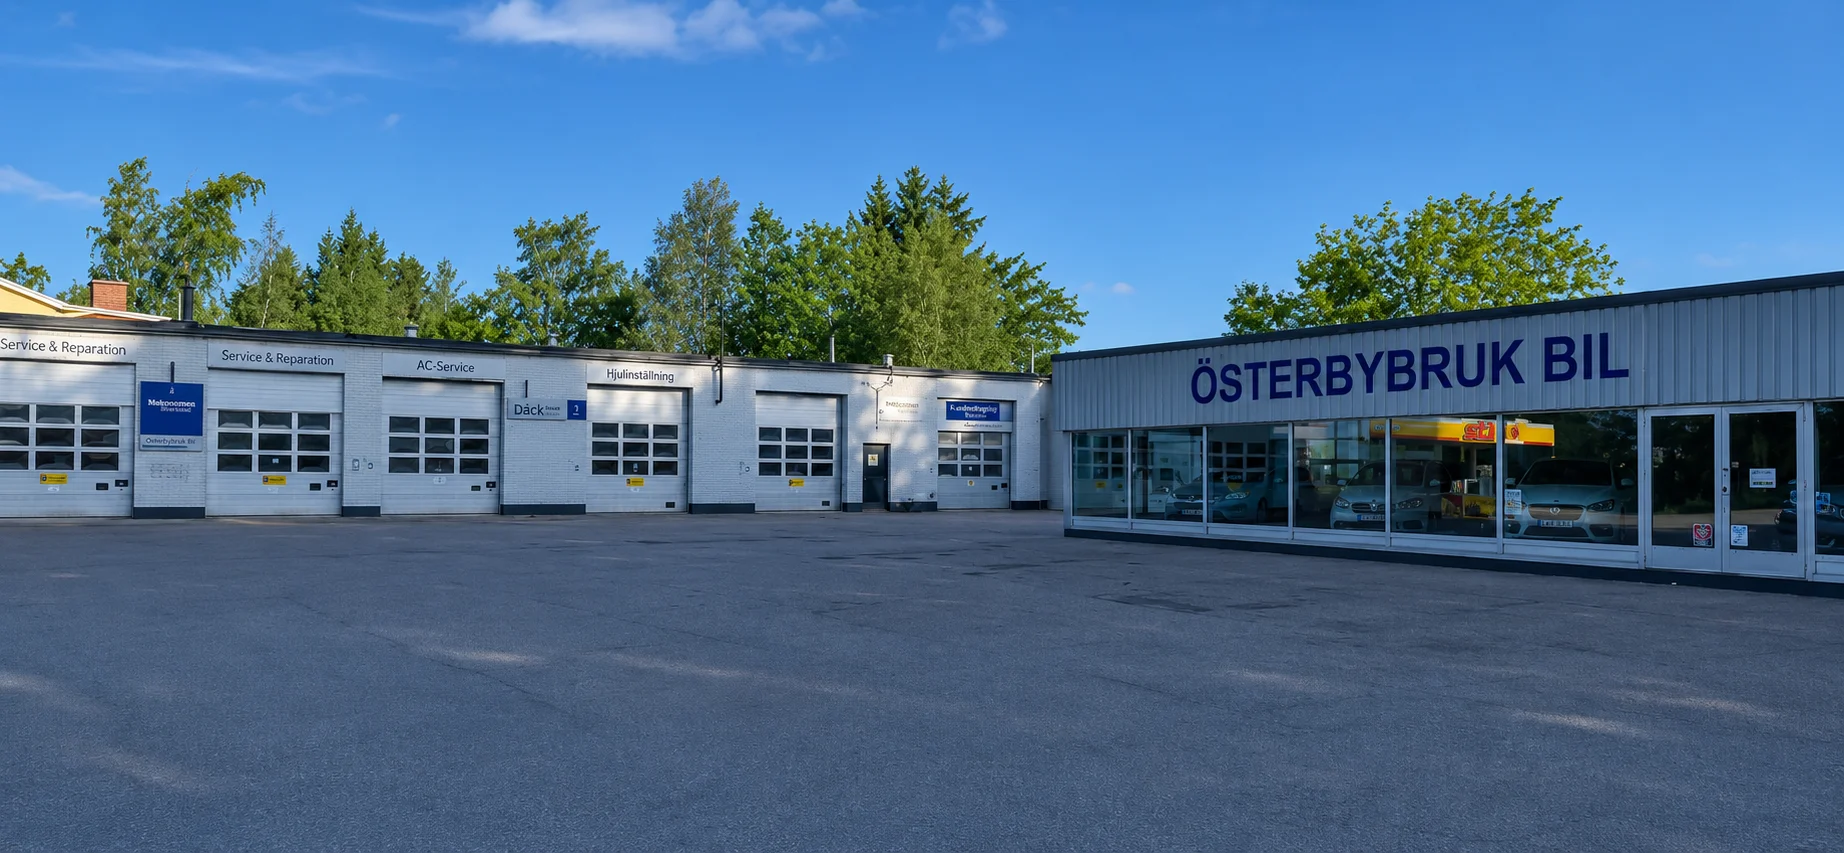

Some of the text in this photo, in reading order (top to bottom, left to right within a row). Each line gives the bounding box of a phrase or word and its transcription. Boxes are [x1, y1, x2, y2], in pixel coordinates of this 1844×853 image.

[0, 338, 127, 357] Service & Reparation
[221, 349, 334, 367] Service & Reparation
[416, 360, 475, 373] AC-Service
[1191, 331, 1630, 404] ÖSTERBYBRUK BIL
